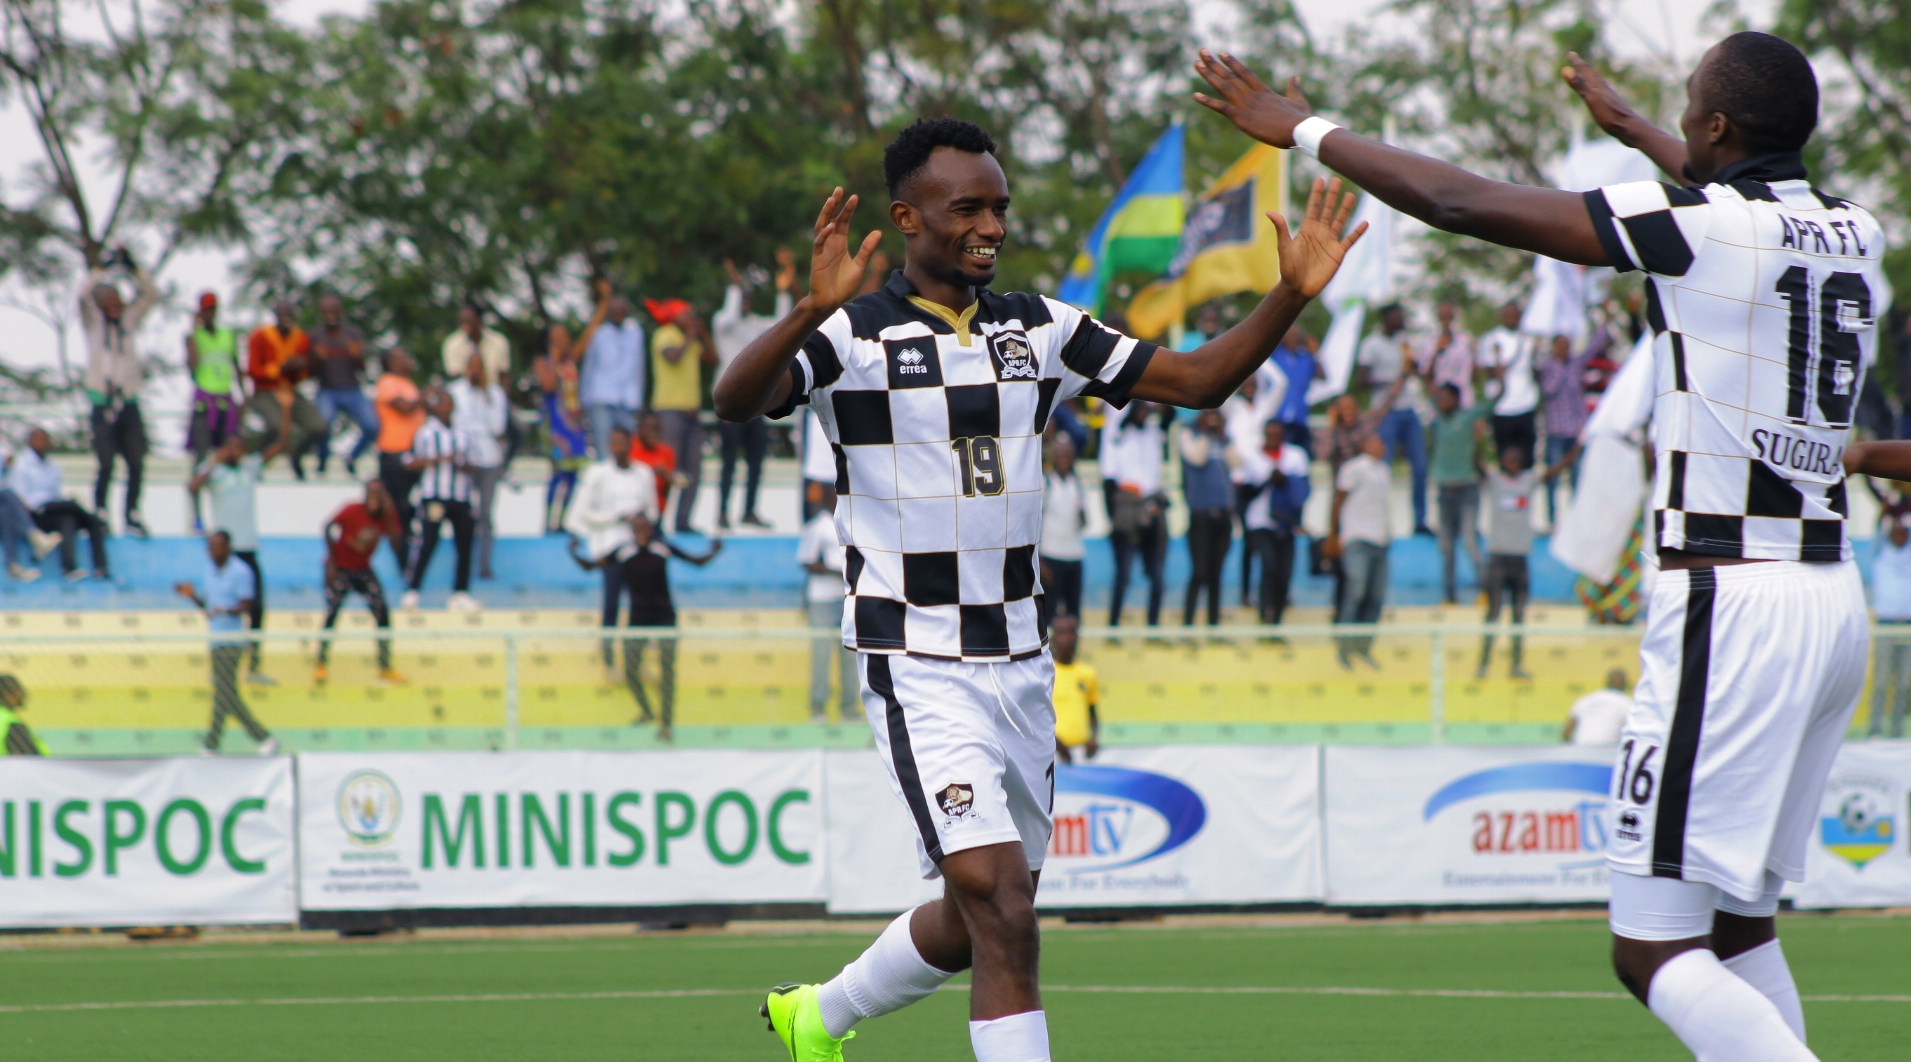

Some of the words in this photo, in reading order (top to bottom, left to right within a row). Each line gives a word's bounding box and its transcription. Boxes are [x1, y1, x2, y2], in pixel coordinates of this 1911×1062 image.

[1778, 213, 1830, 254] APR
[1828, 219, 1867, 256] FC
[1775, 265, 1873, 429] 16
[952, 435, 1005, 498] 19
[1618, 739, 1660, 805] 16
[421, 788, 812, 869] MINISPOC
